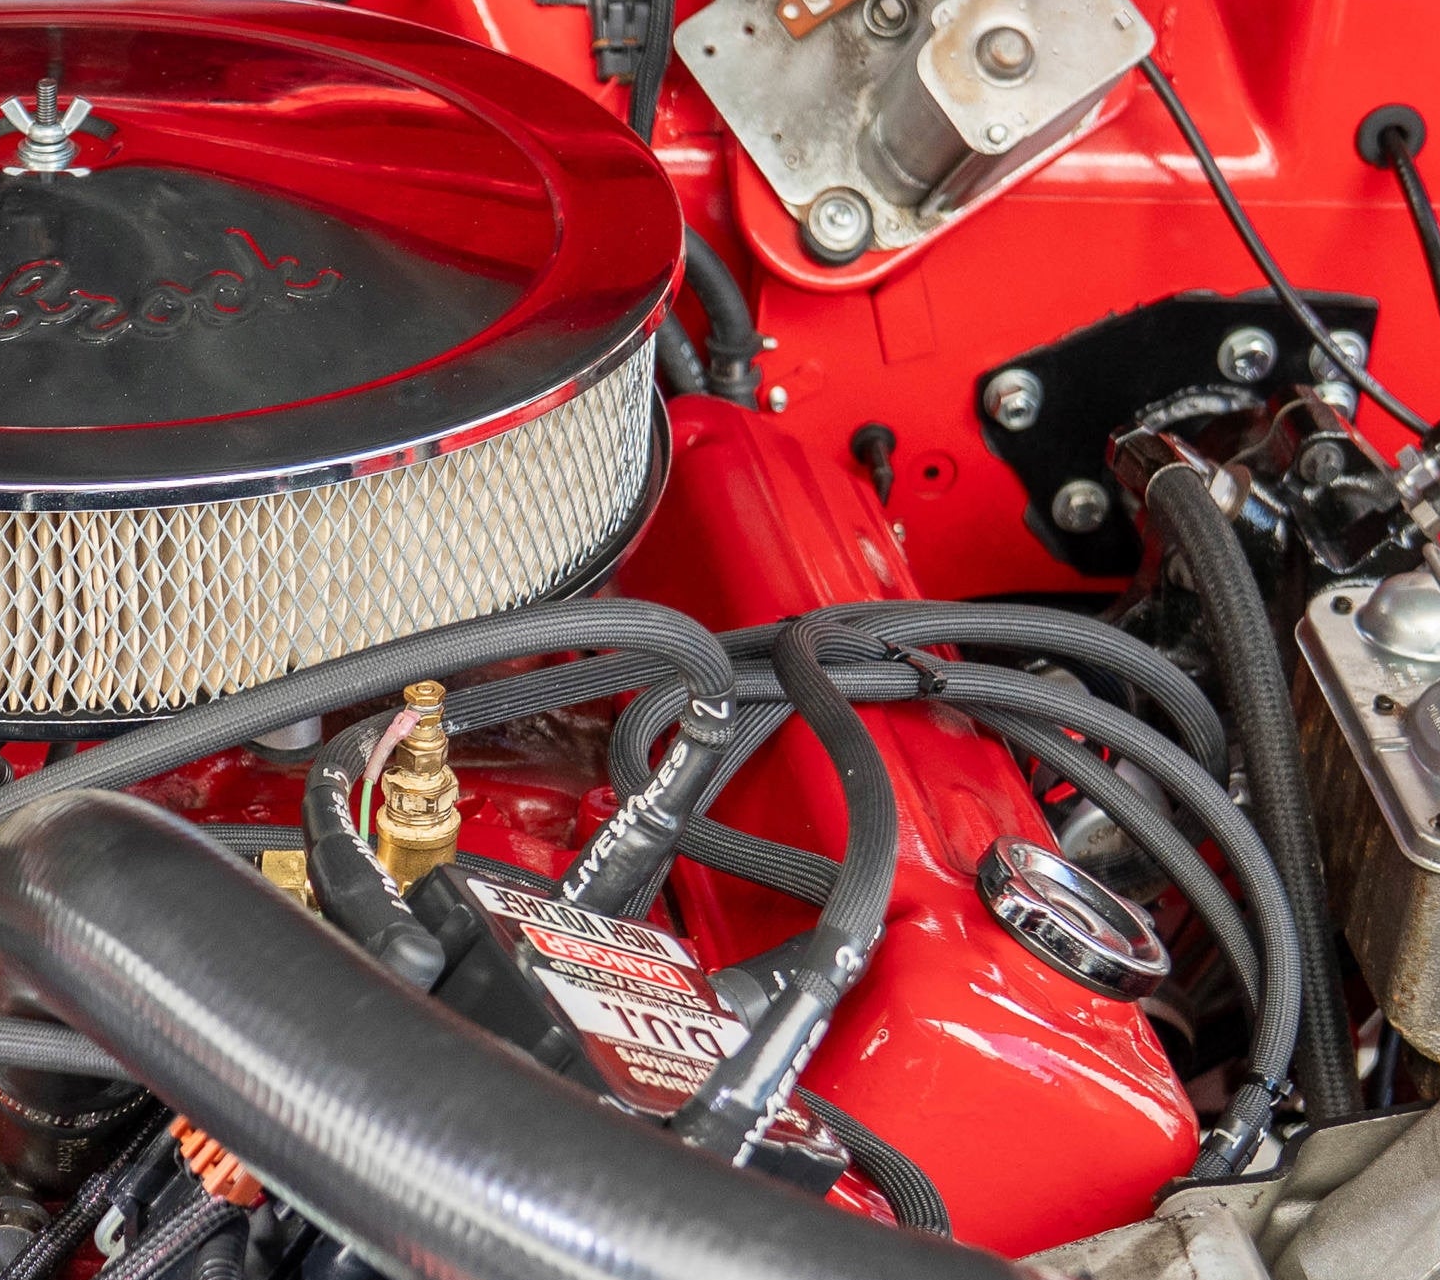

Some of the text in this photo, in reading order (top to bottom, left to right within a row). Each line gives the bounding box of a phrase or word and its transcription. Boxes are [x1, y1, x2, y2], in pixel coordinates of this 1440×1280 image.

[693, 698, 732, 720] 2
[562, 742, 688, 900] LIVEWIRES
[484, 885, 669, 955] HIGH VOLTAGE
[542, 933, 671, 985] DANGER
[550, 960, 710, 1012] STREET/STRIP
